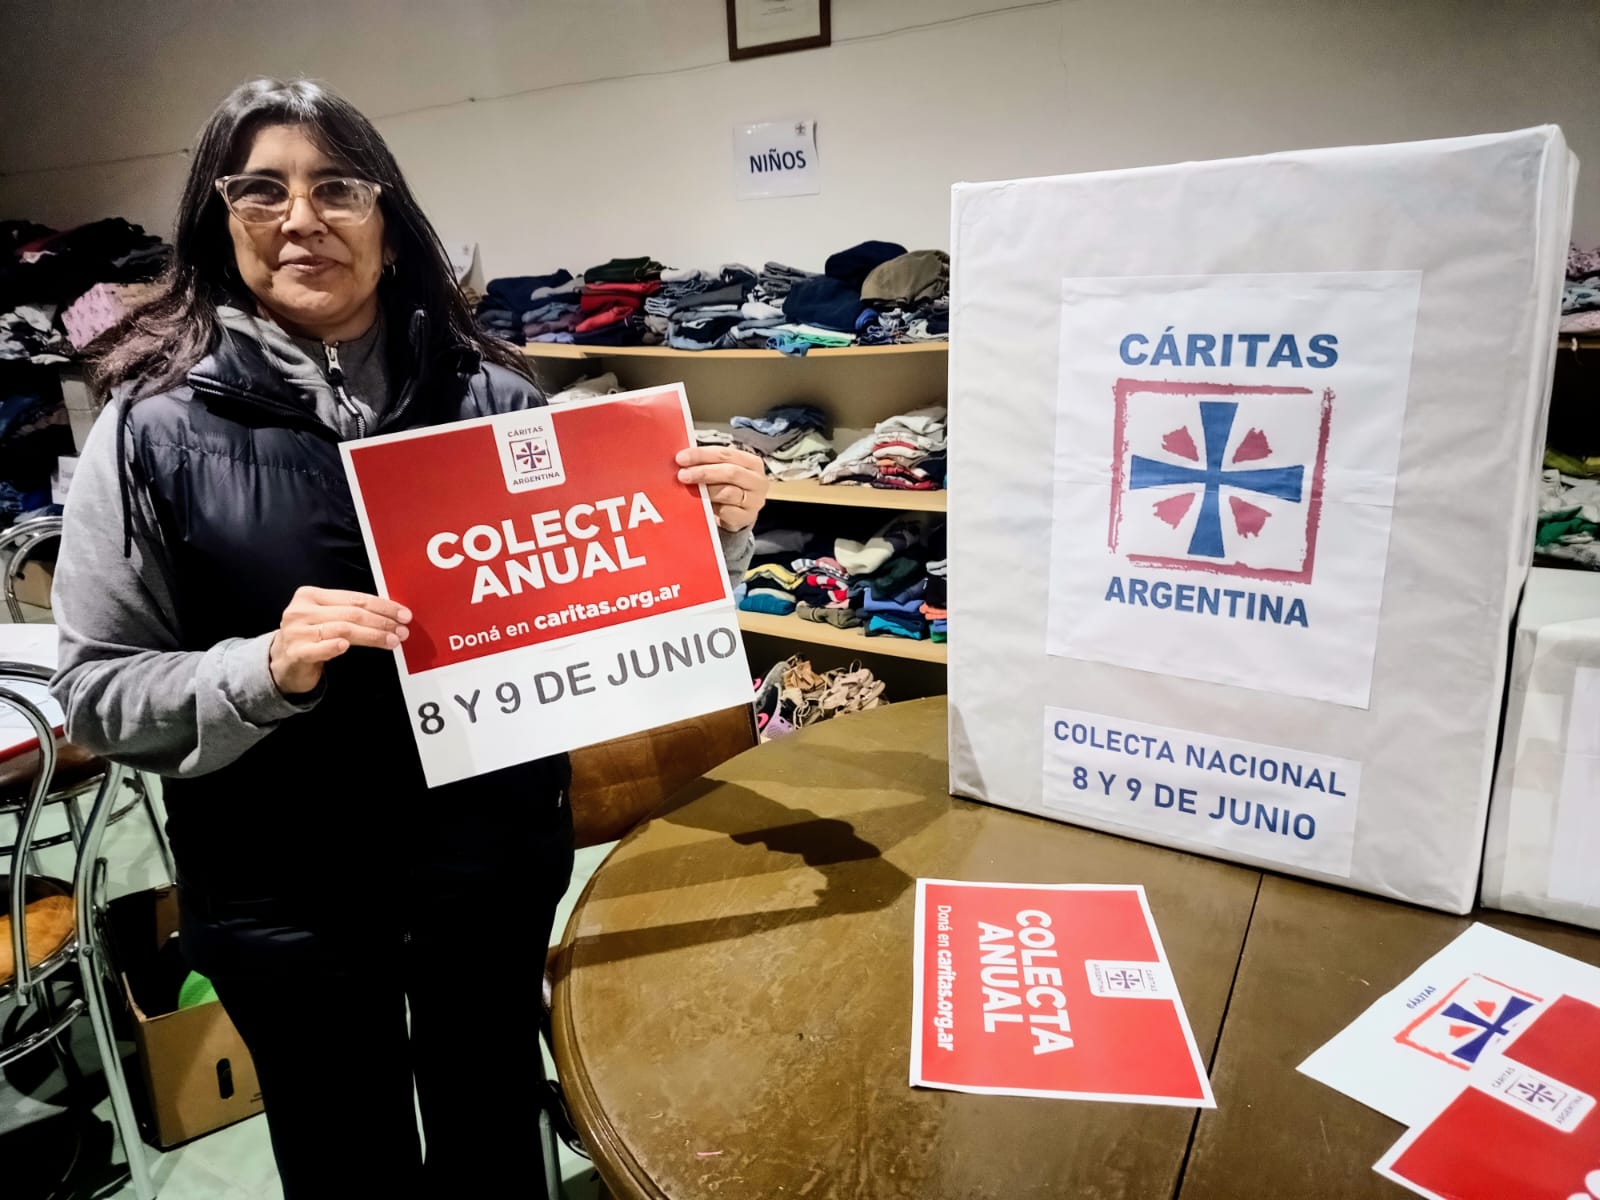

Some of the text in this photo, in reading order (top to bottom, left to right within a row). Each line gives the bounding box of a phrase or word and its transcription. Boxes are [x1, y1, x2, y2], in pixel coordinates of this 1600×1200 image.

[750, 148, 806, 173] NIÑOS
[1119, 326, 1339, 369] CÁRITAS
[513, 472, 560, 486] ARGENTINA
[426, 491, 664, 570] COLECTA
[470, 536, 647, 604] ANUAL
[1104, 576, 1309, 628] ARGENTINA
[448, 582, 681, 651] Doná en caritas.org.ar
[417, 626, 737, 735] 8 Y 9 DE JUNIO
[1053, 720, 1347, 797] COLECTA NACIONAL
[1072, 766, 1316, 840] 8 Y 9 DE JUNIO
[934, 905, 957, 1051] Doná en caritas.org.ar
[977, 921, 1024, 1033] ANUAL
[1015, 909, 1075, 1055] COLECTA
